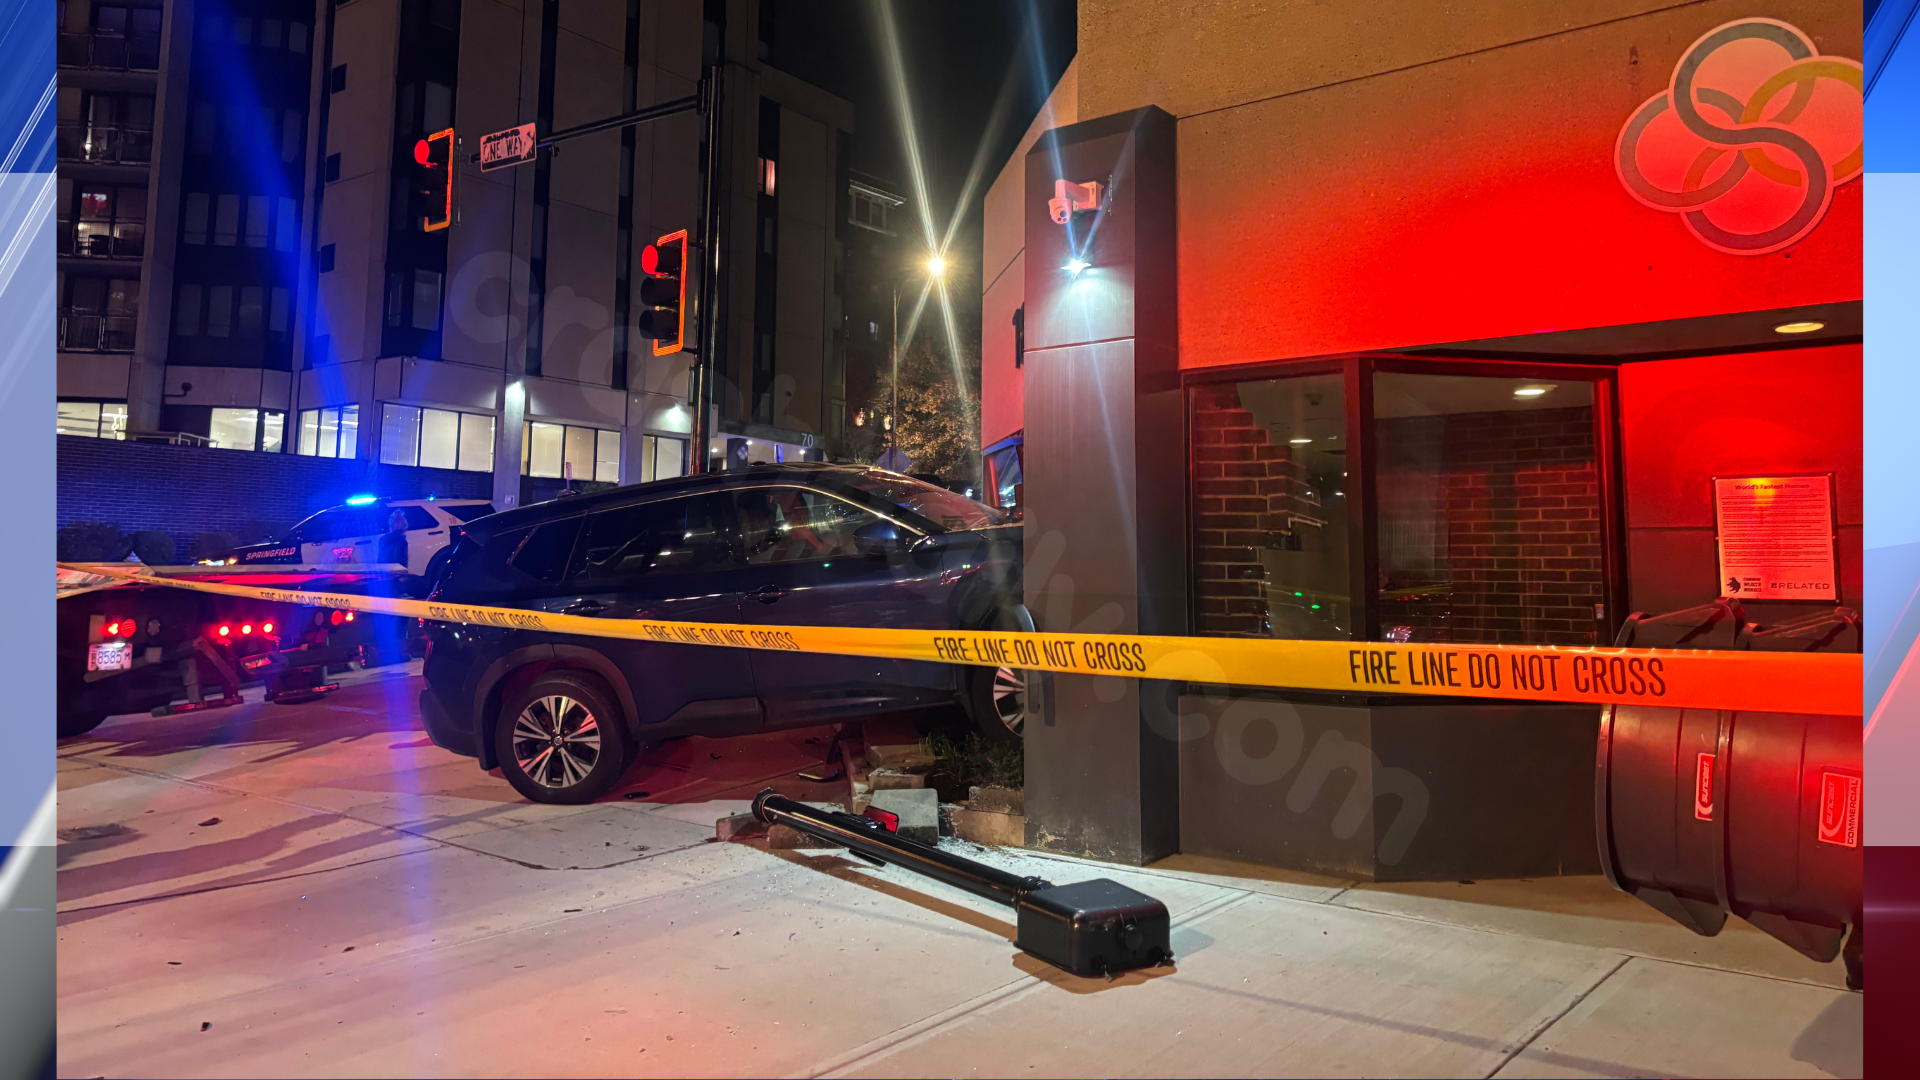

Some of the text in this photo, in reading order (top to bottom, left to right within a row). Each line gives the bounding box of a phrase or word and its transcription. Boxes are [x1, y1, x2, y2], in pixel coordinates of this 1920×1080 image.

[483, 136, 523, 162] ONE WAY
[801, 433, 814, 448] 70
[245, 547, 296, 561] SPRINGFIELD
[1778, 582, 1830, 590] RELATED
[643, 624, 800, 650] FIRE LINE DO NOT CROSS
[934, 637, 1146, 672] FIRE LINE DO NOT CROSS
[1350, 650, 1666, 697] FIRE LINE DO NOT CROSS
[1847, 778, 1859, 845] COMMERCIAL
